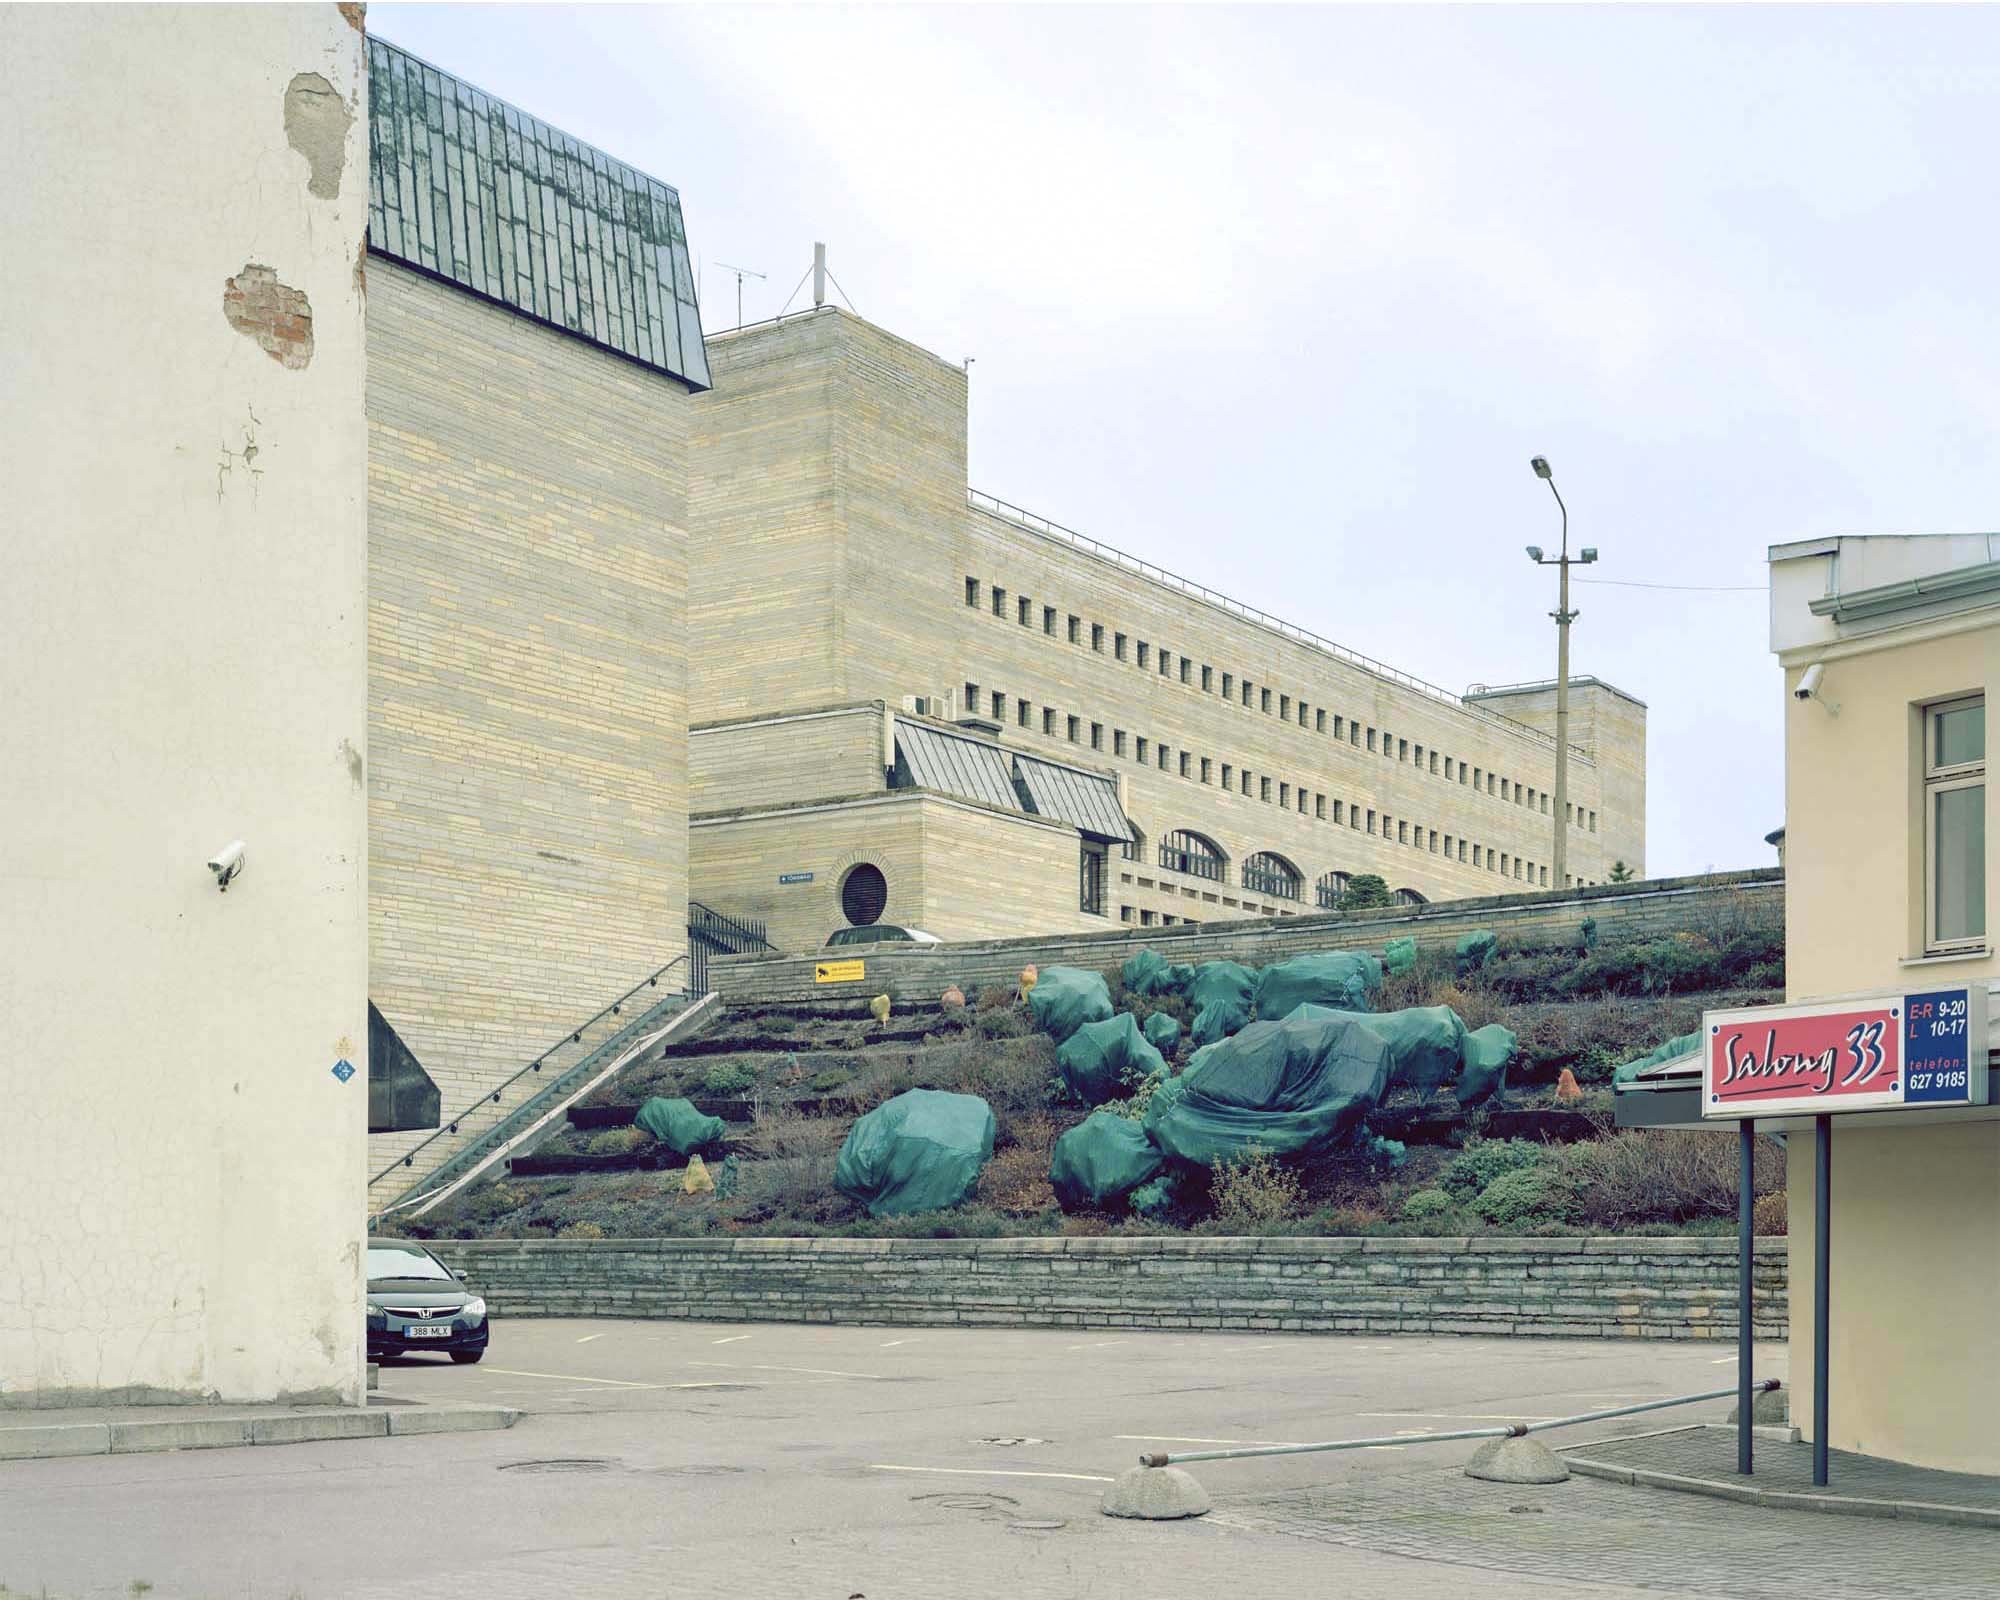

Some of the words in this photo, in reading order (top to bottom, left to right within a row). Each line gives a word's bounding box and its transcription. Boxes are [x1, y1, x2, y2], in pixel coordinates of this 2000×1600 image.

[1909, 1002, 1933, 1020] E-R
[1938, 999, 1966, 1017] 9-20
[1909, 1023, 1920, 1039] L
[1930, 1018, 1966, 1037] 10-17
[1719, 1028, 1838, 1093] Salong
[1841, 1019, 1887, 1087] 33
[1909, 1073, 1933, 1090] 627
[1935, 1071, 1966, 1089] 9185
[413, 1327, 428, 1336] 388
[431, 1327, 448, 1336] MLX
